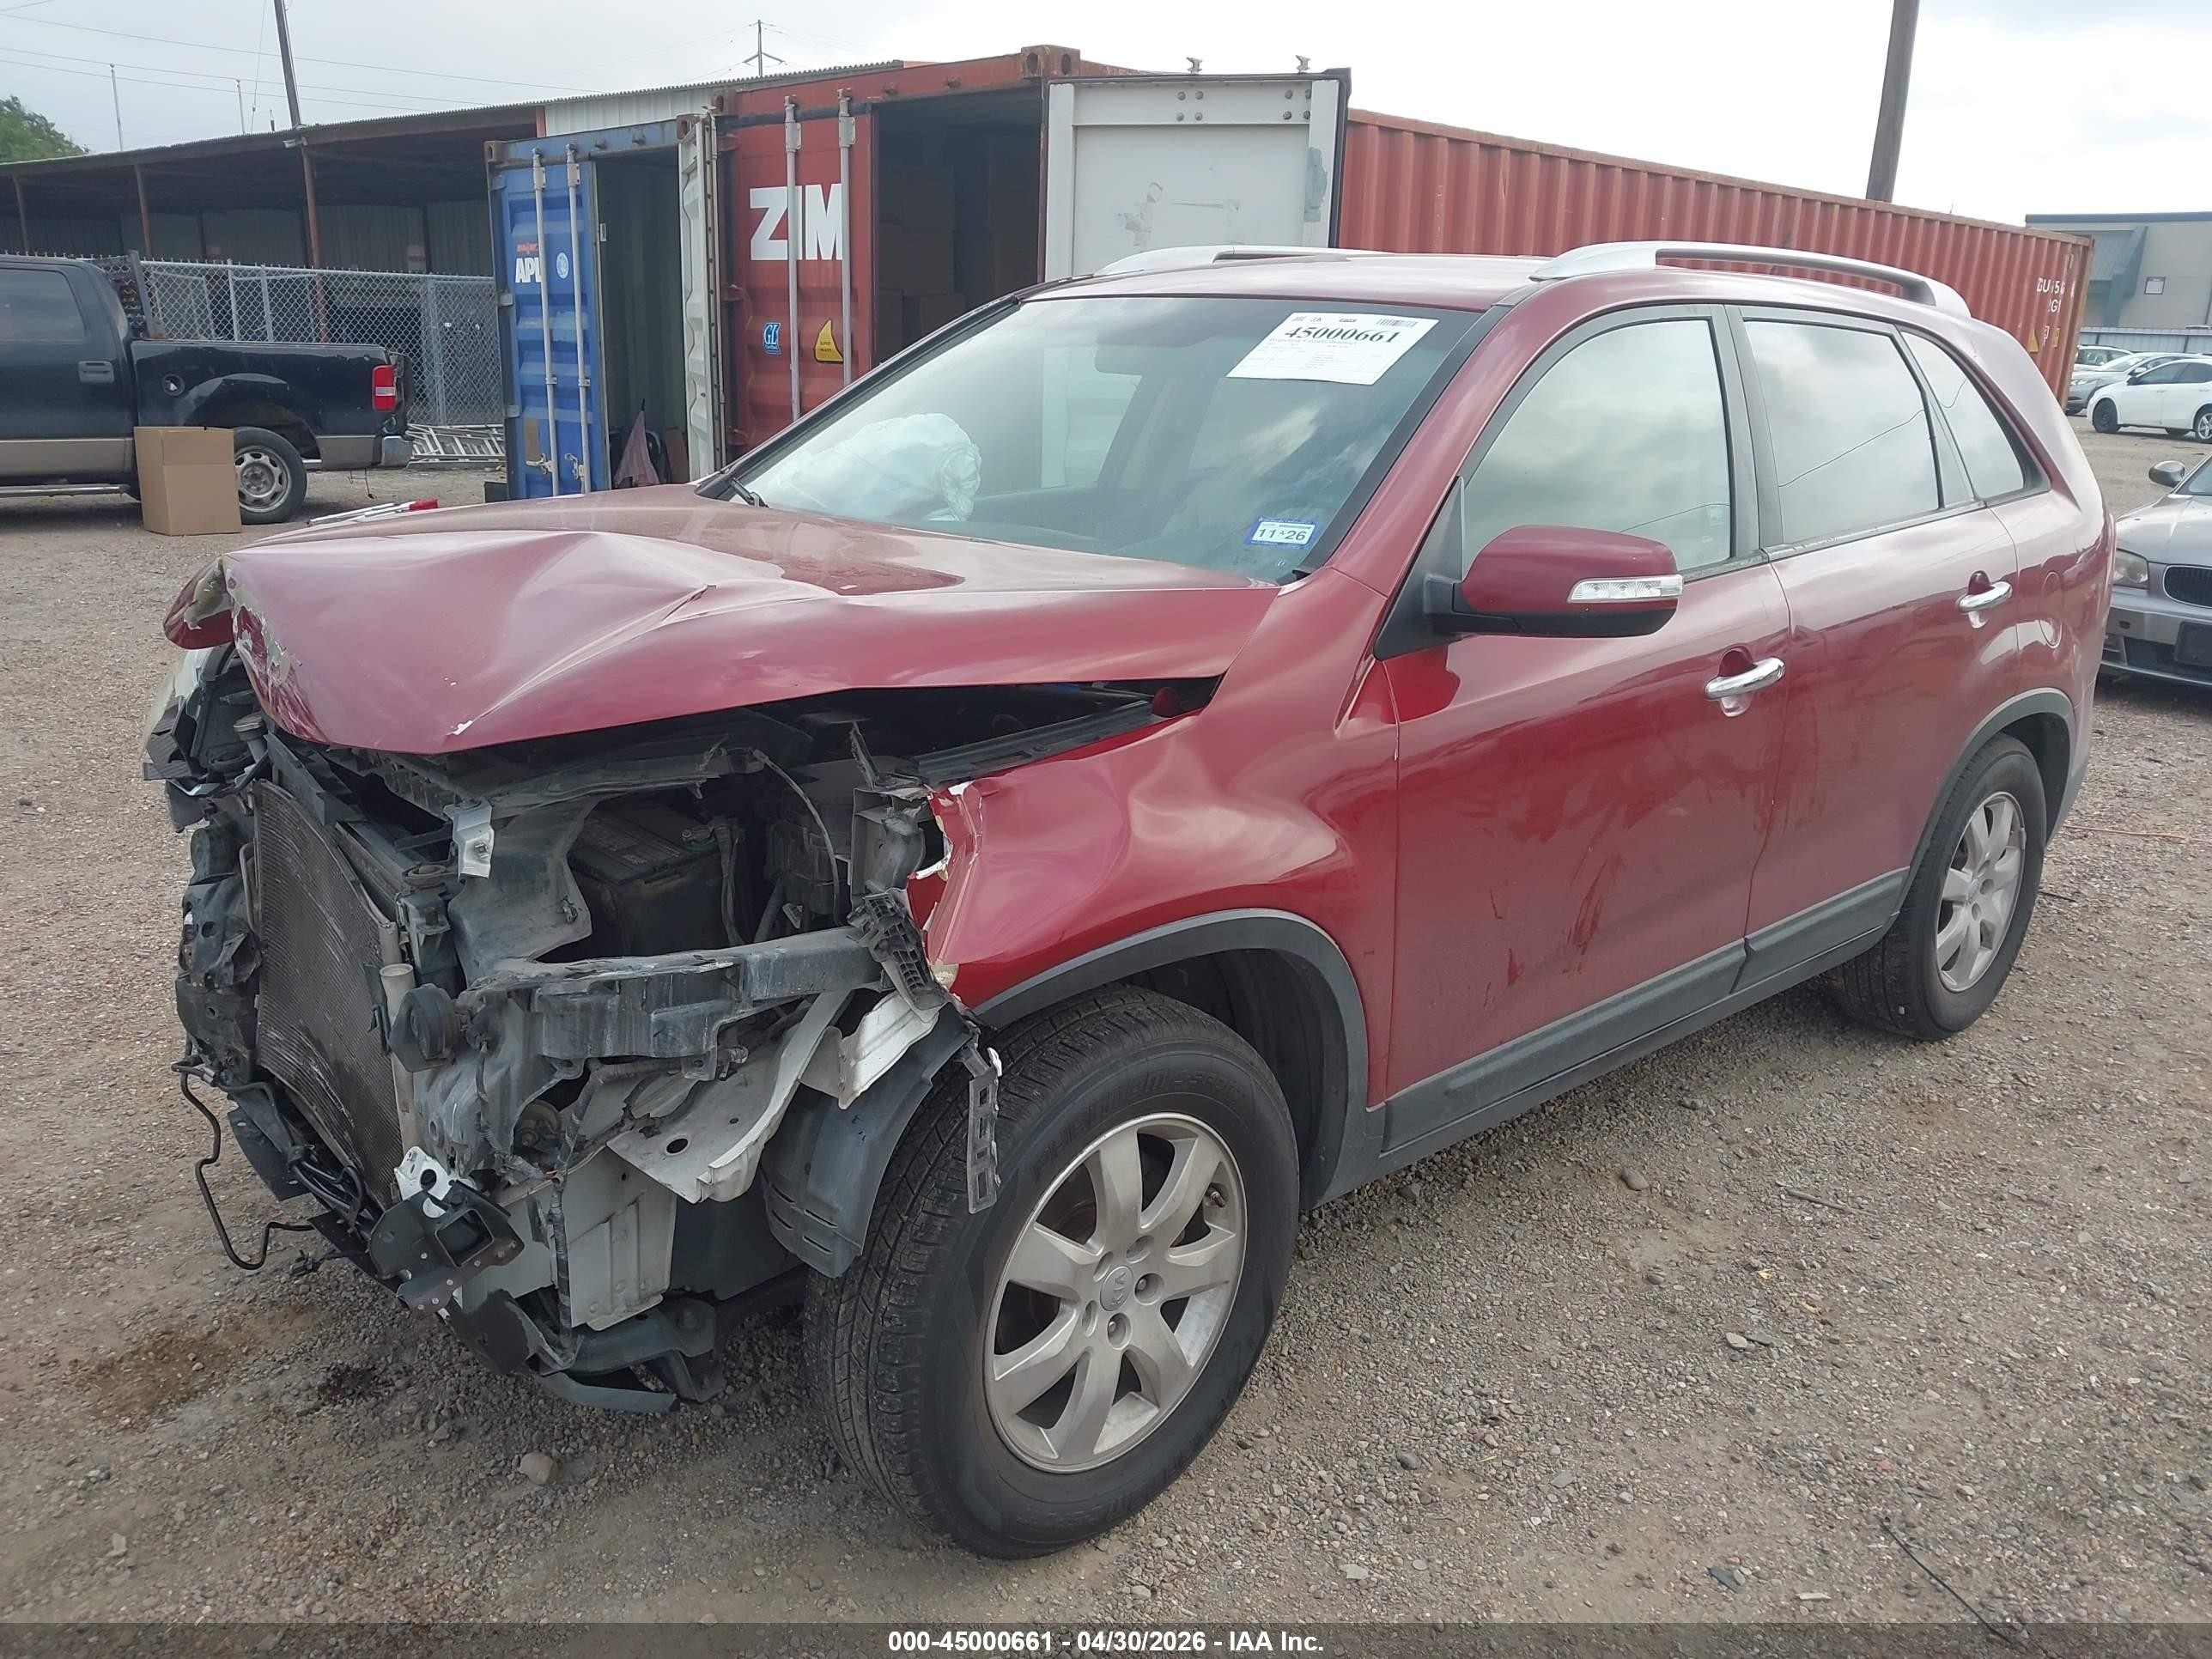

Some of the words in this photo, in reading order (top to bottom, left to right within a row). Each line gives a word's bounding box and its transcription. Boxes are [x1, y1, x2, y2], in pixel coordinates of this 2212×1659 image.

[749, 183, 842, 260] ZIM
[1285, 326, 1401, 343] 45000661
[1285, 530, 1307, 541] 26
[1111, 1271, 1126, 1306] KIA
